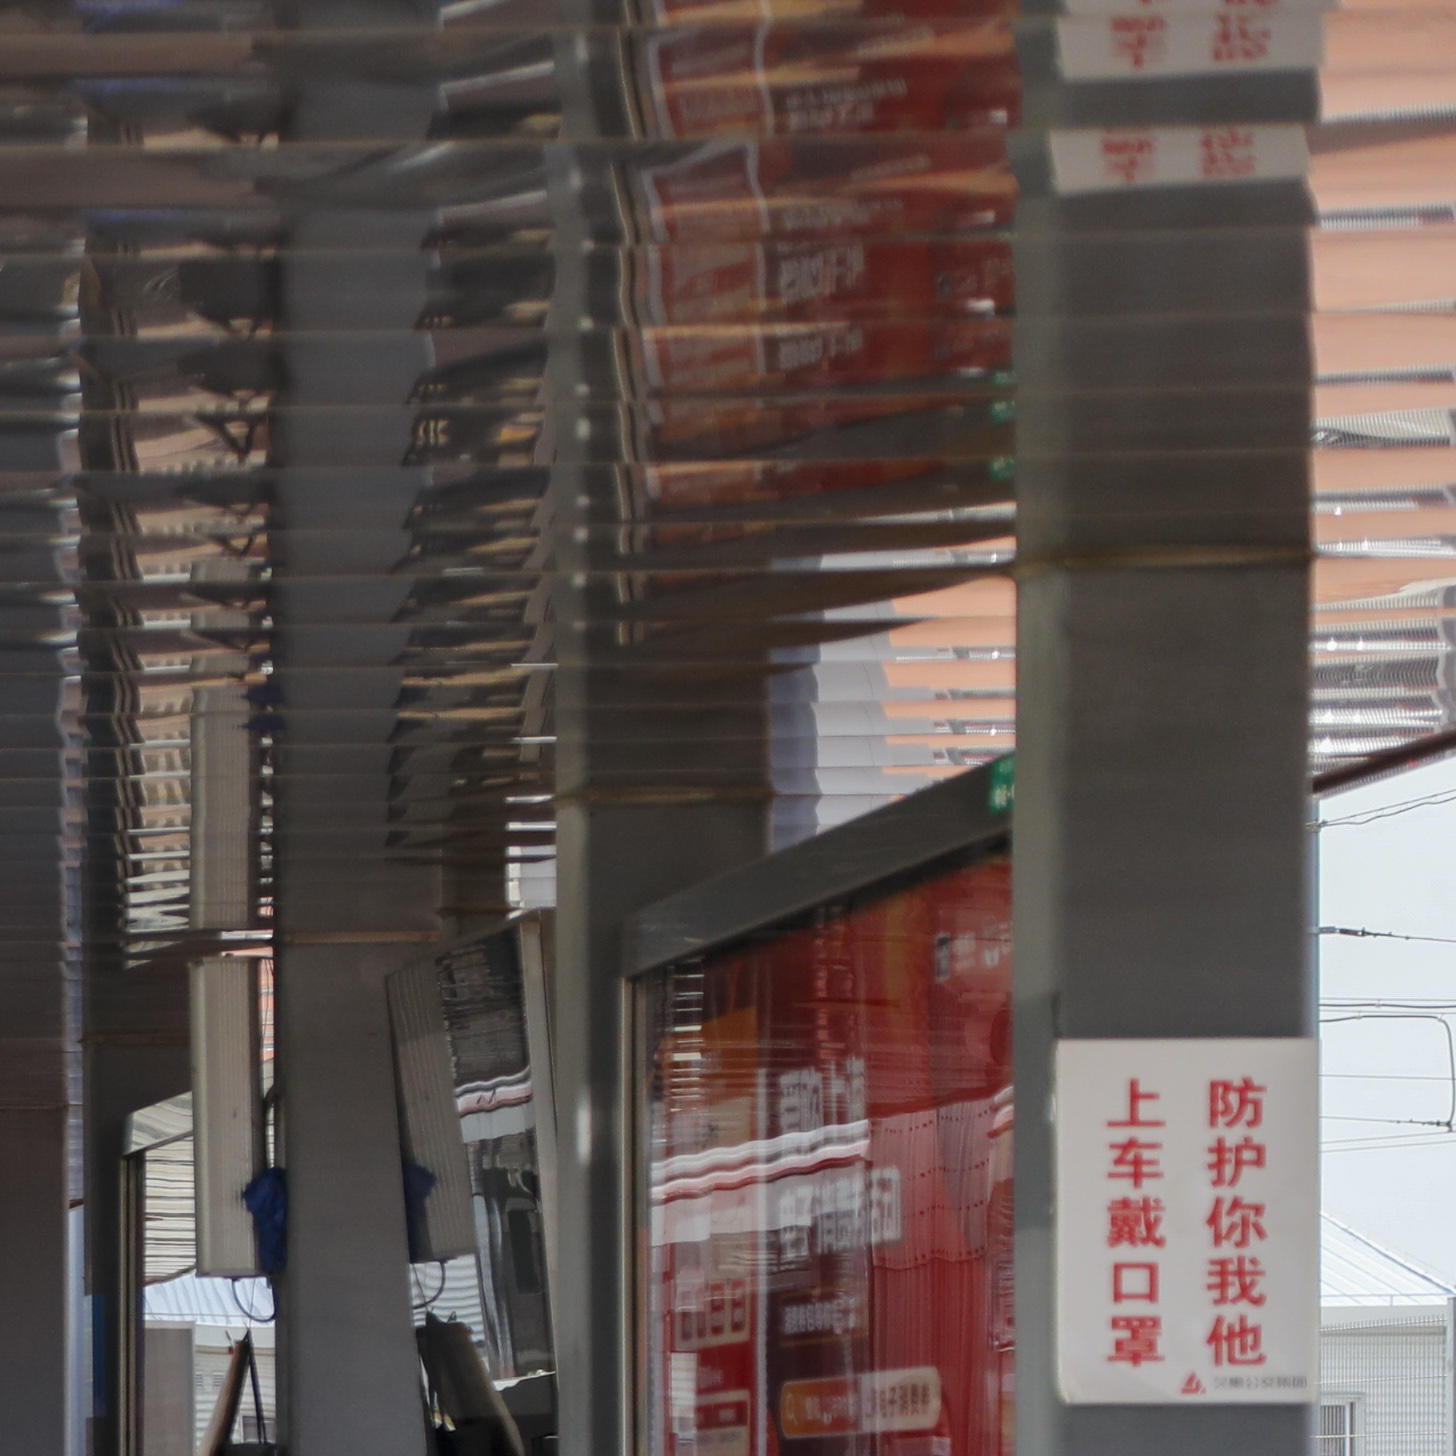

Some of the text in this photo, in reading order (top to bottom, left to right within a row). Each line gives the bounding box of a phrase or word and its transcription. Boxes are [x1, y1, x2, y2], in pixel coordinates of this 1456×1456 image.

[1106, 1078, 1167, 1368] 上车戴口罩
[1206, 1077, 1268, 1367] 防护你我他
